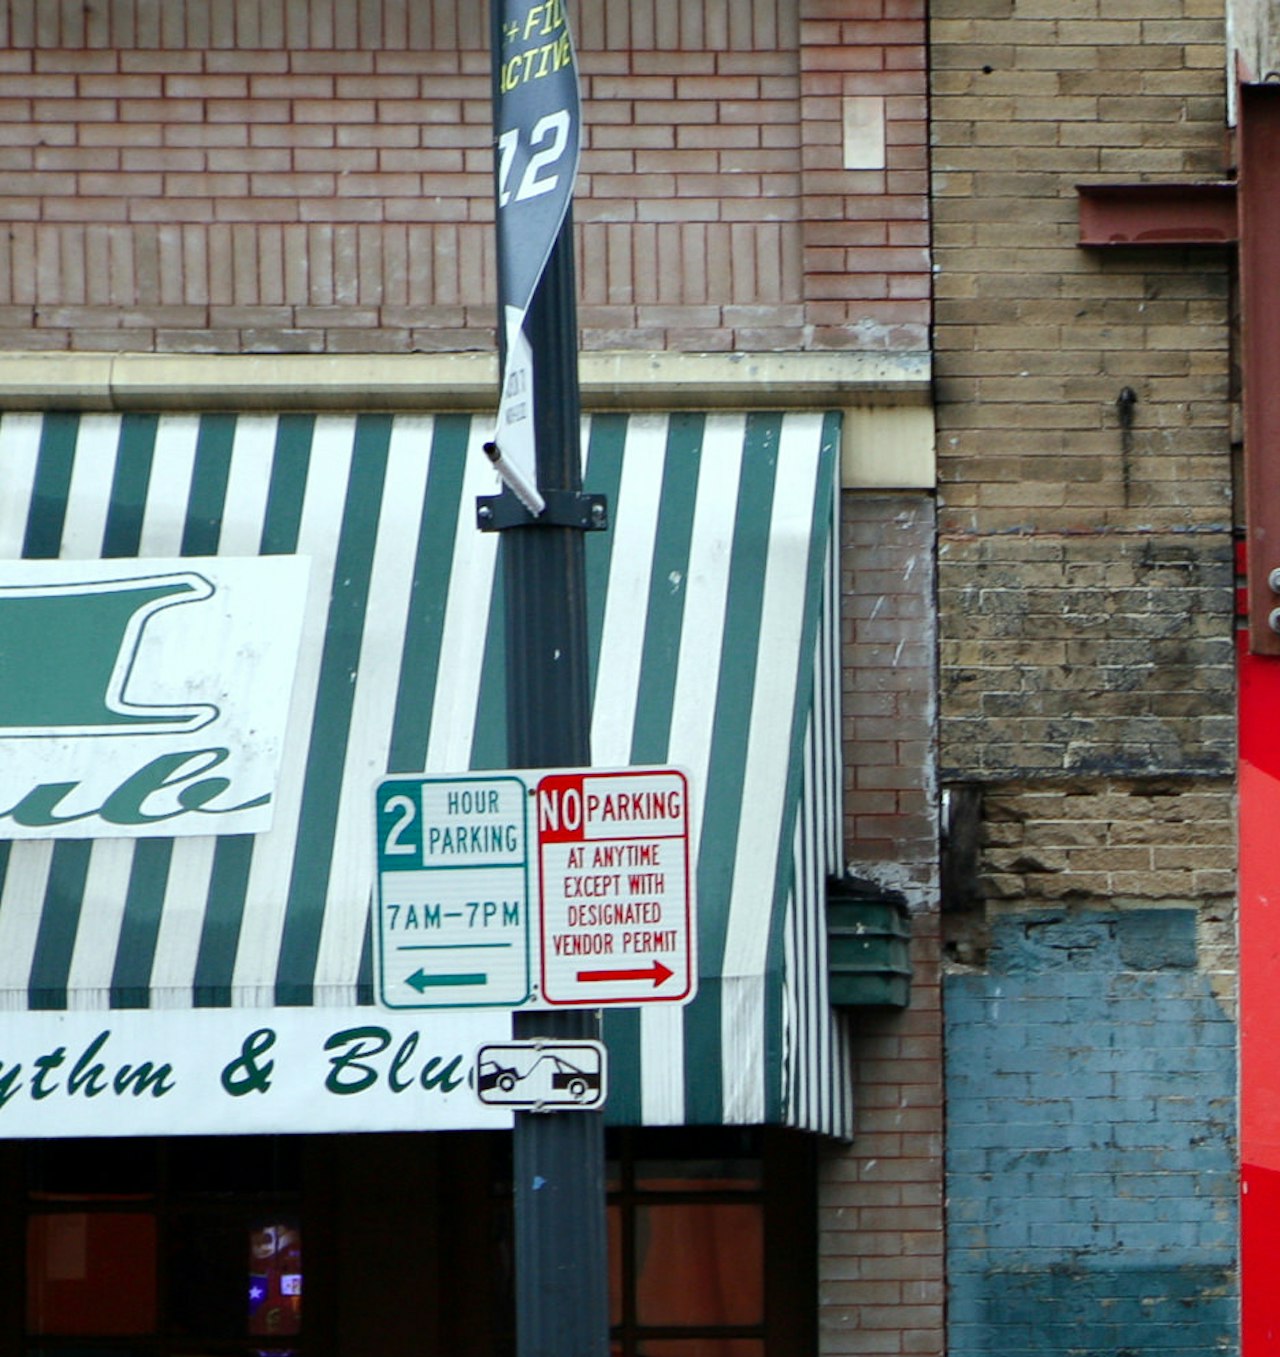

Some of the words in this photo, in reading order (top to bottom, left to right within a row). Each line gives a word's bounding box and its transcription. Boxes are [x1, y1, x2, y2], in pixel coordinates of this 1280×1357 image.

[383, 794, 417, 855] 2
[448, 790, 500, 815] HOUR
[539, 788, 582, 832] NO
[587, 791, 681, 822] PARKING
[429, 825, 518, 854] PARKING
[567, 847, 584, 869] AT
[592, 844, 661, 868] ANYTIME
[564, 874, 621, 898] EXCEPT
[628, 873, 665, 896] WITH
[568, 902, 662, 927] DESIGNATED
[553, 933, 613, 956] VENDOR
[623, 930, 677, 954] PERMIT
[221, 1027, 277, 1097] &
[324, 1025, 475, 1096] Blu
